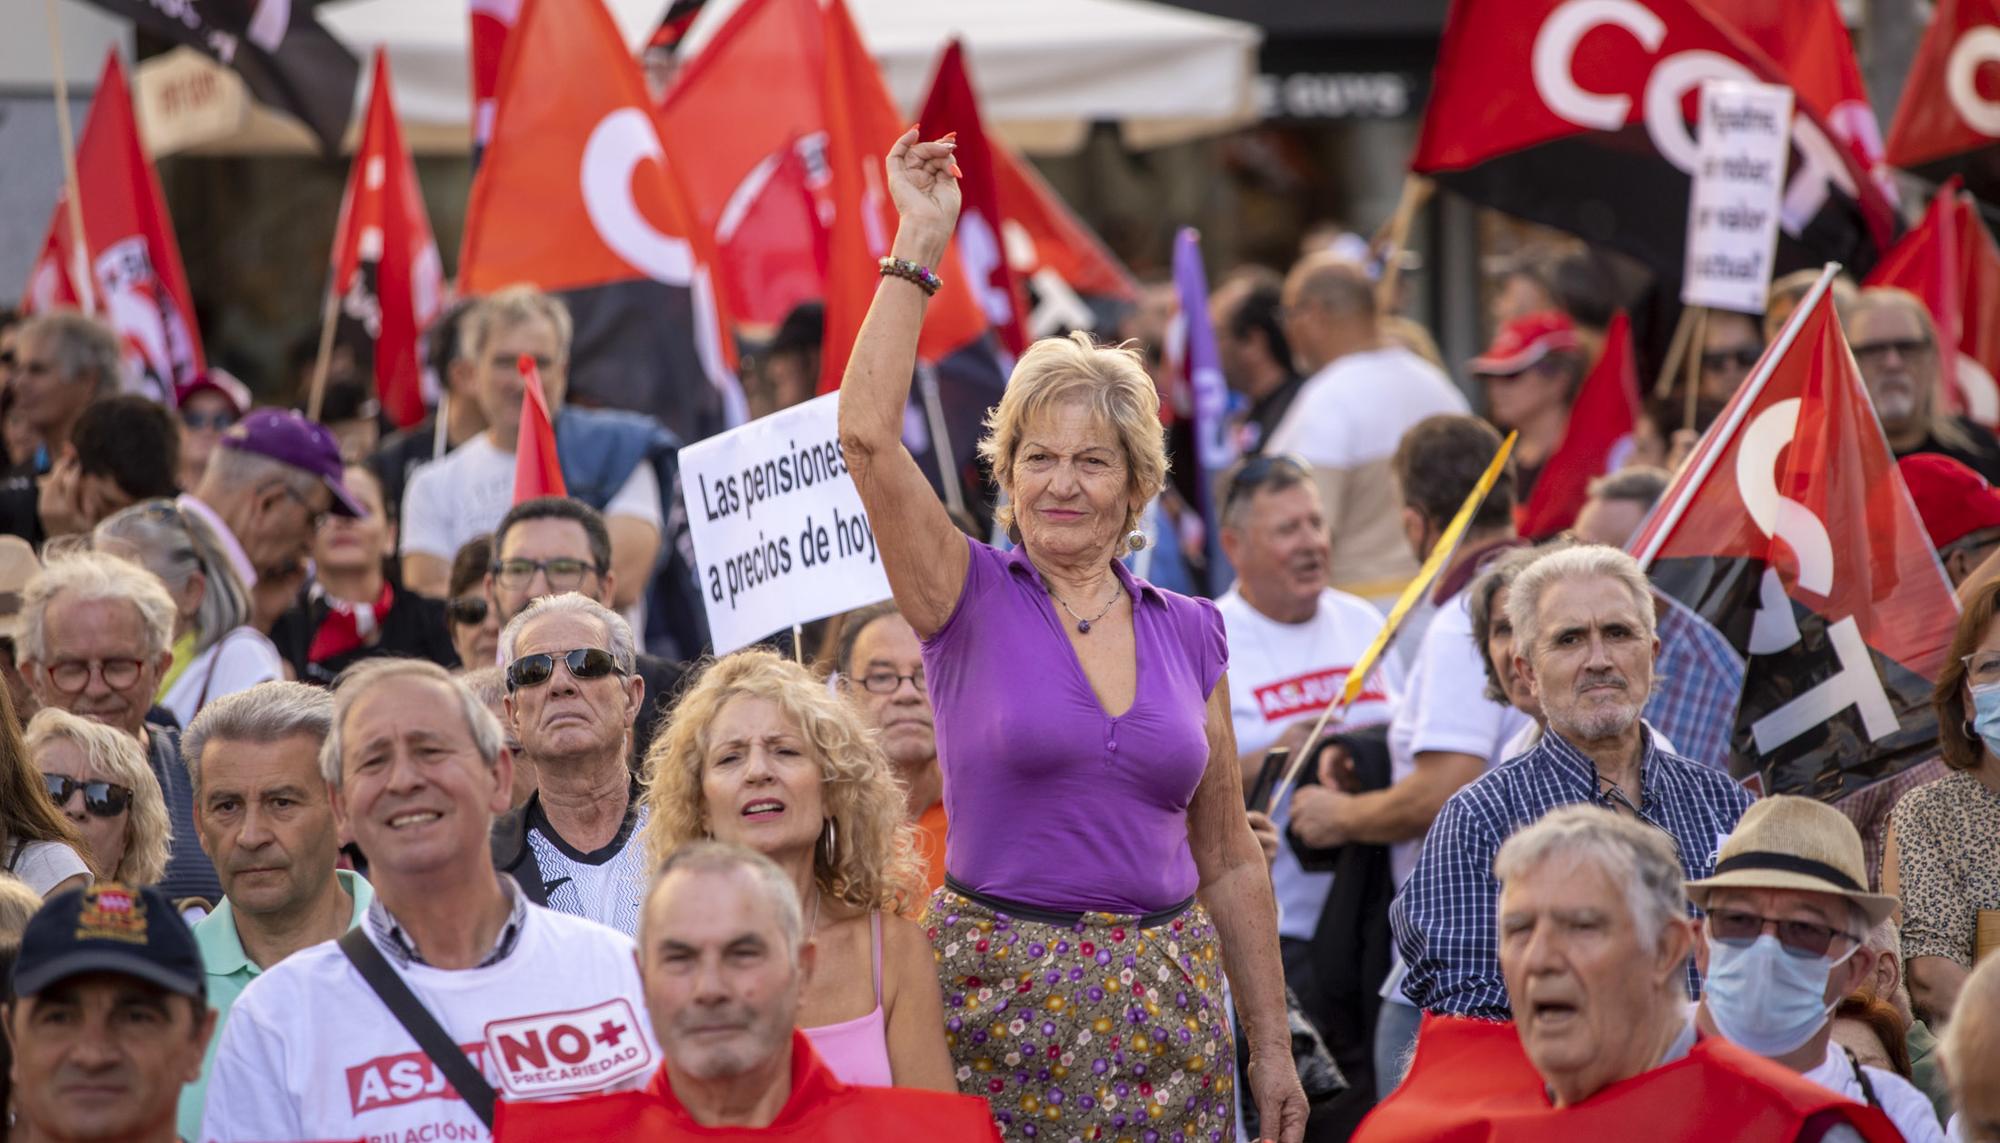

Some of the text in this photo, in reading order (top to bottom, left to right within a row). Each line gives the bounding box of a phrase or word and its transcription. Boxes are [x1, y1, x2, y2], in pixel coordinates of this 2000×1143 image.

[698, 438, 848, 522] Las pensiones
[708, 507, 876, 610] a precios de hoy
[512, 1046, 639, 1085] PRECARIEDAD
